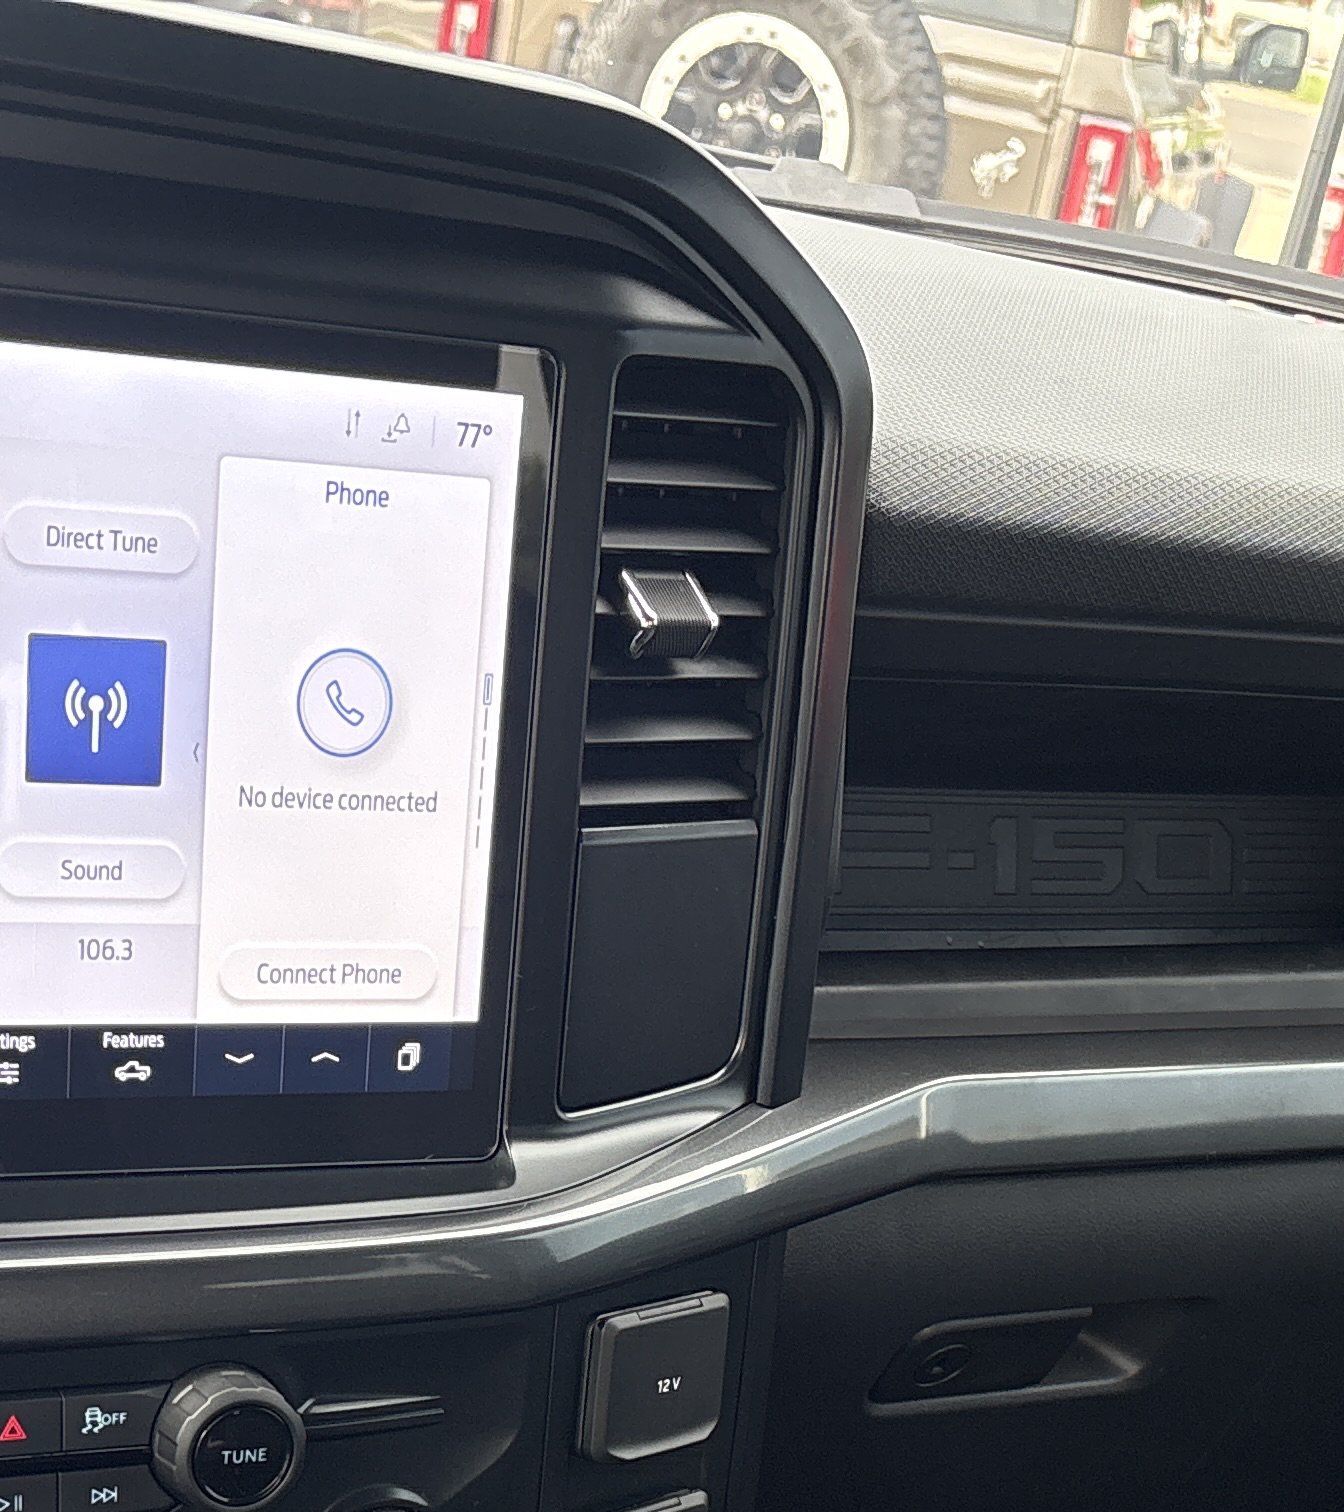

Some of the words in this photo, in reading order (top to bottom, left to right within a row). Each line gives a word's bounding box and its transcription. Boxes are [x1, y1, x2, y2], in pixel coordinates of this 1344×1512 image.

[325, 480, 390, 508] Phone
[46, 525, 105, 551] Direct
[108, 529, 158, 554] Tune
[238, 784, 267, 808] No
[271, 785, 334, 810] device
[337, 790, 438, 813] connected
[60, 859, 123, 881] Sound
[78, 938, 133, 961] 106.3
[256, 962, 337, 985] Connect
[341, 962, 402, 985] Phone
[102, 1031, 165, 1049] Features
[657, 1379, 670, 1394] 12
[672, 1376, 682, 1391] V
[101, 1411, 127, 1426] OFF
[221, 1447, 268, 1465] TUNE
